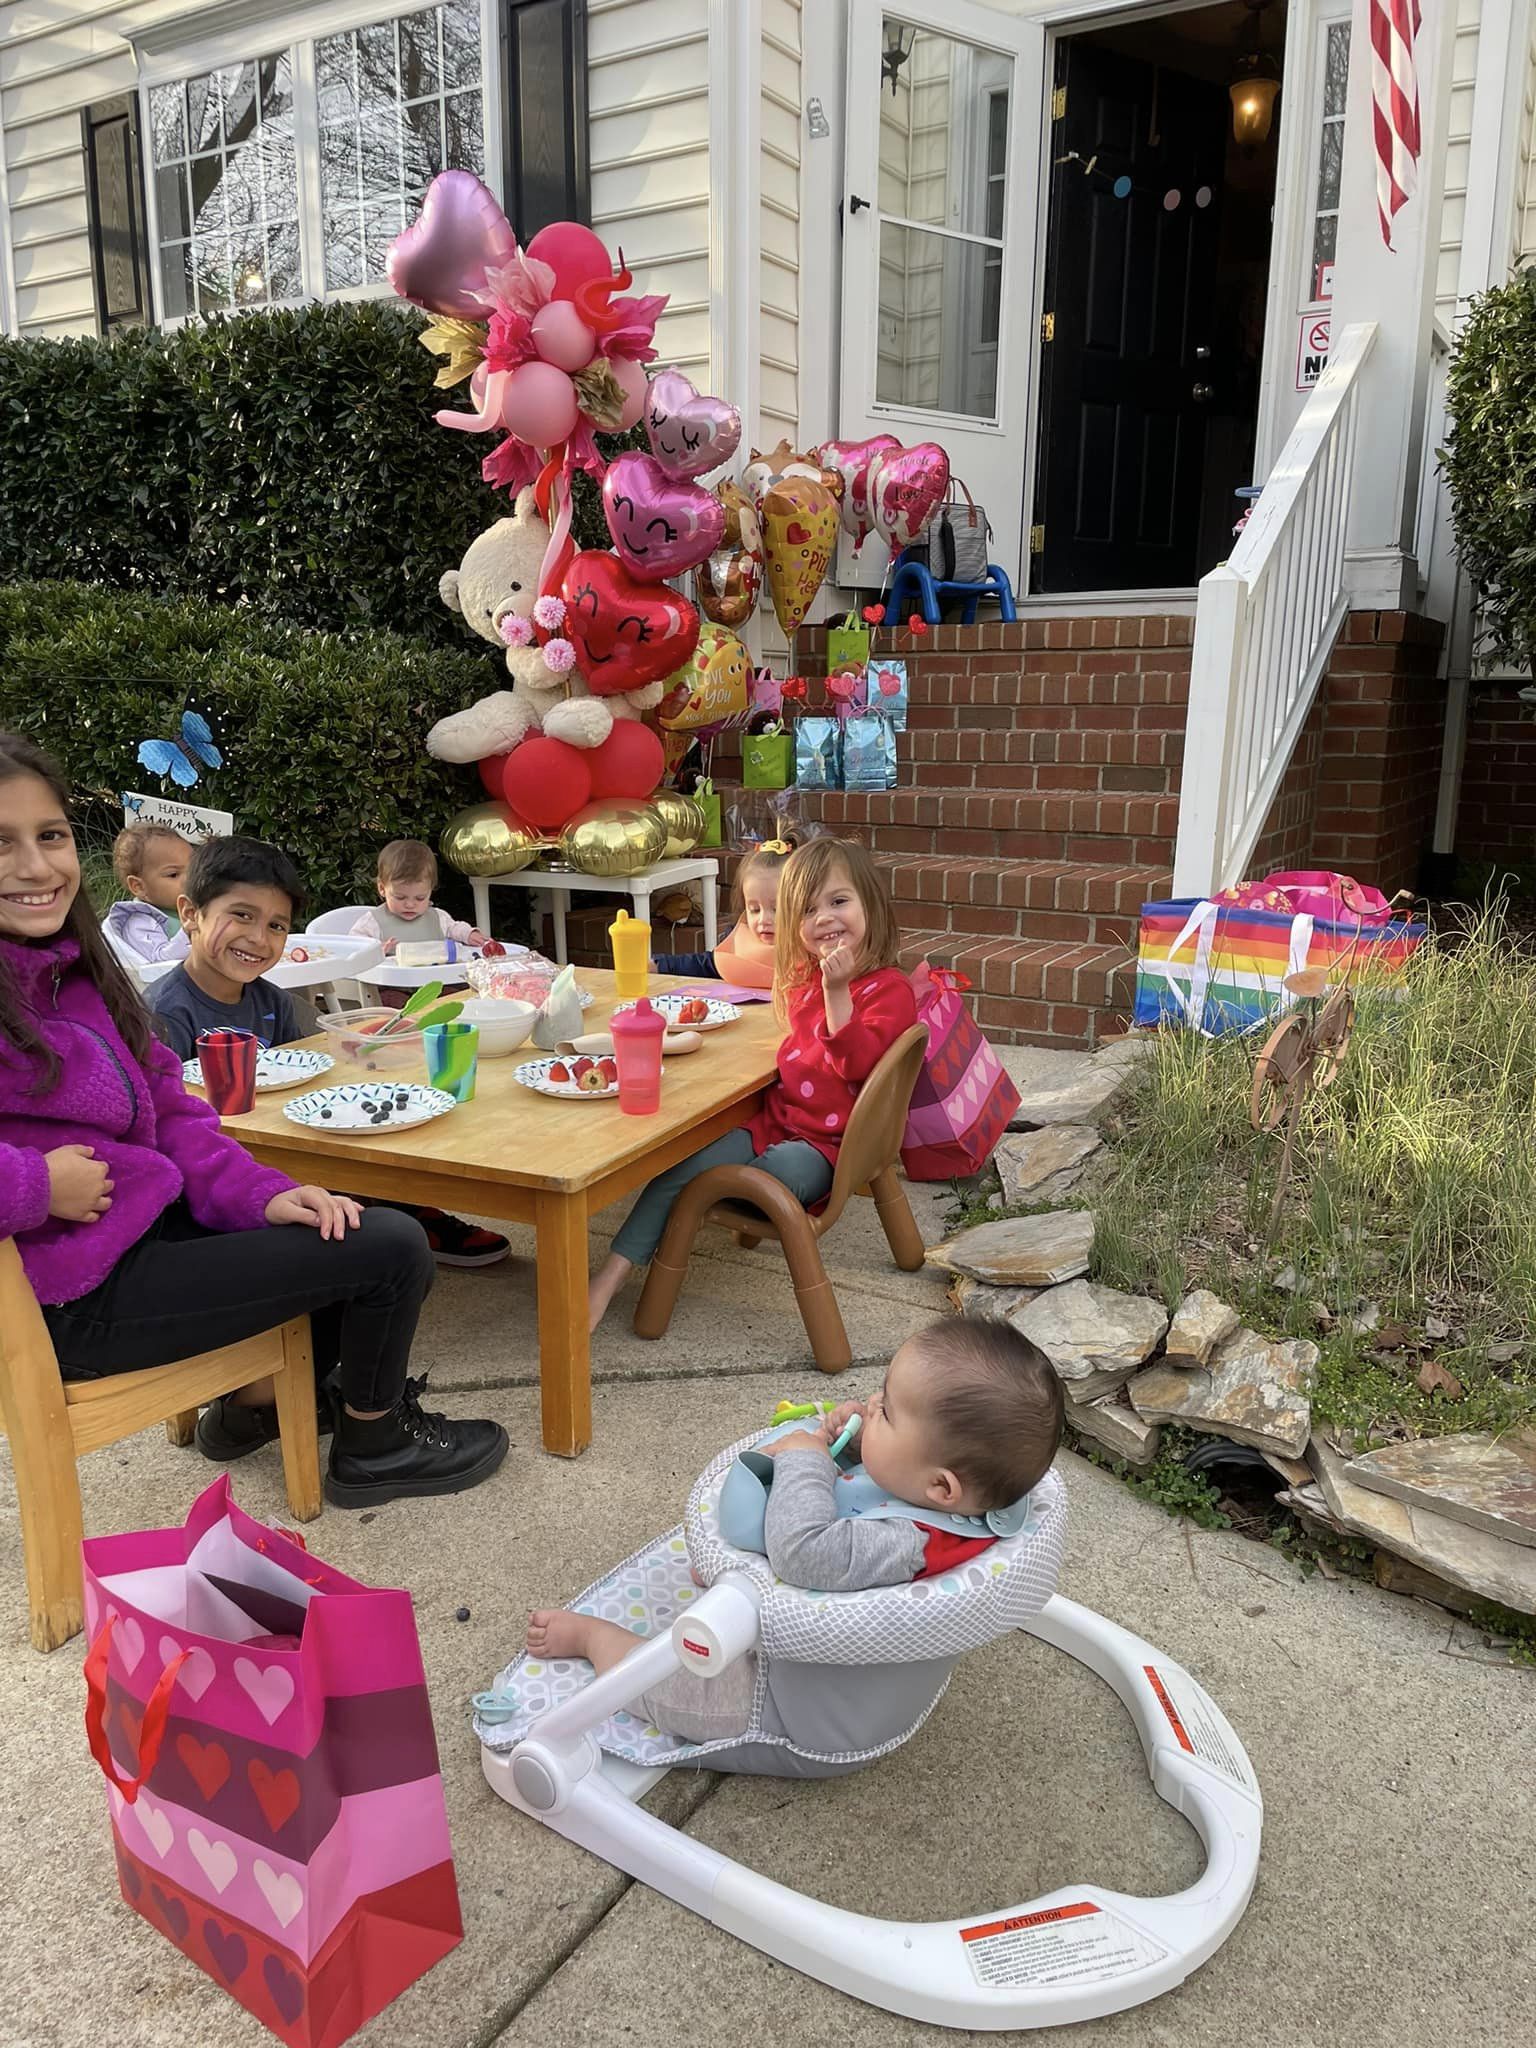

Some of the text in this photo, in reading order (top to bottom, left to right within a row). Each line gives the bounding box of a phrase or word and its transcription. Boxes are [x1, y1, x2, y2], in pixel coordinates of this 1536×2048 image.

[694, 666, 725, 689] LOVE
[158, 803, 198, 819] HAPPY
[1012, 1911, 1062, 1928] ATTENTION
